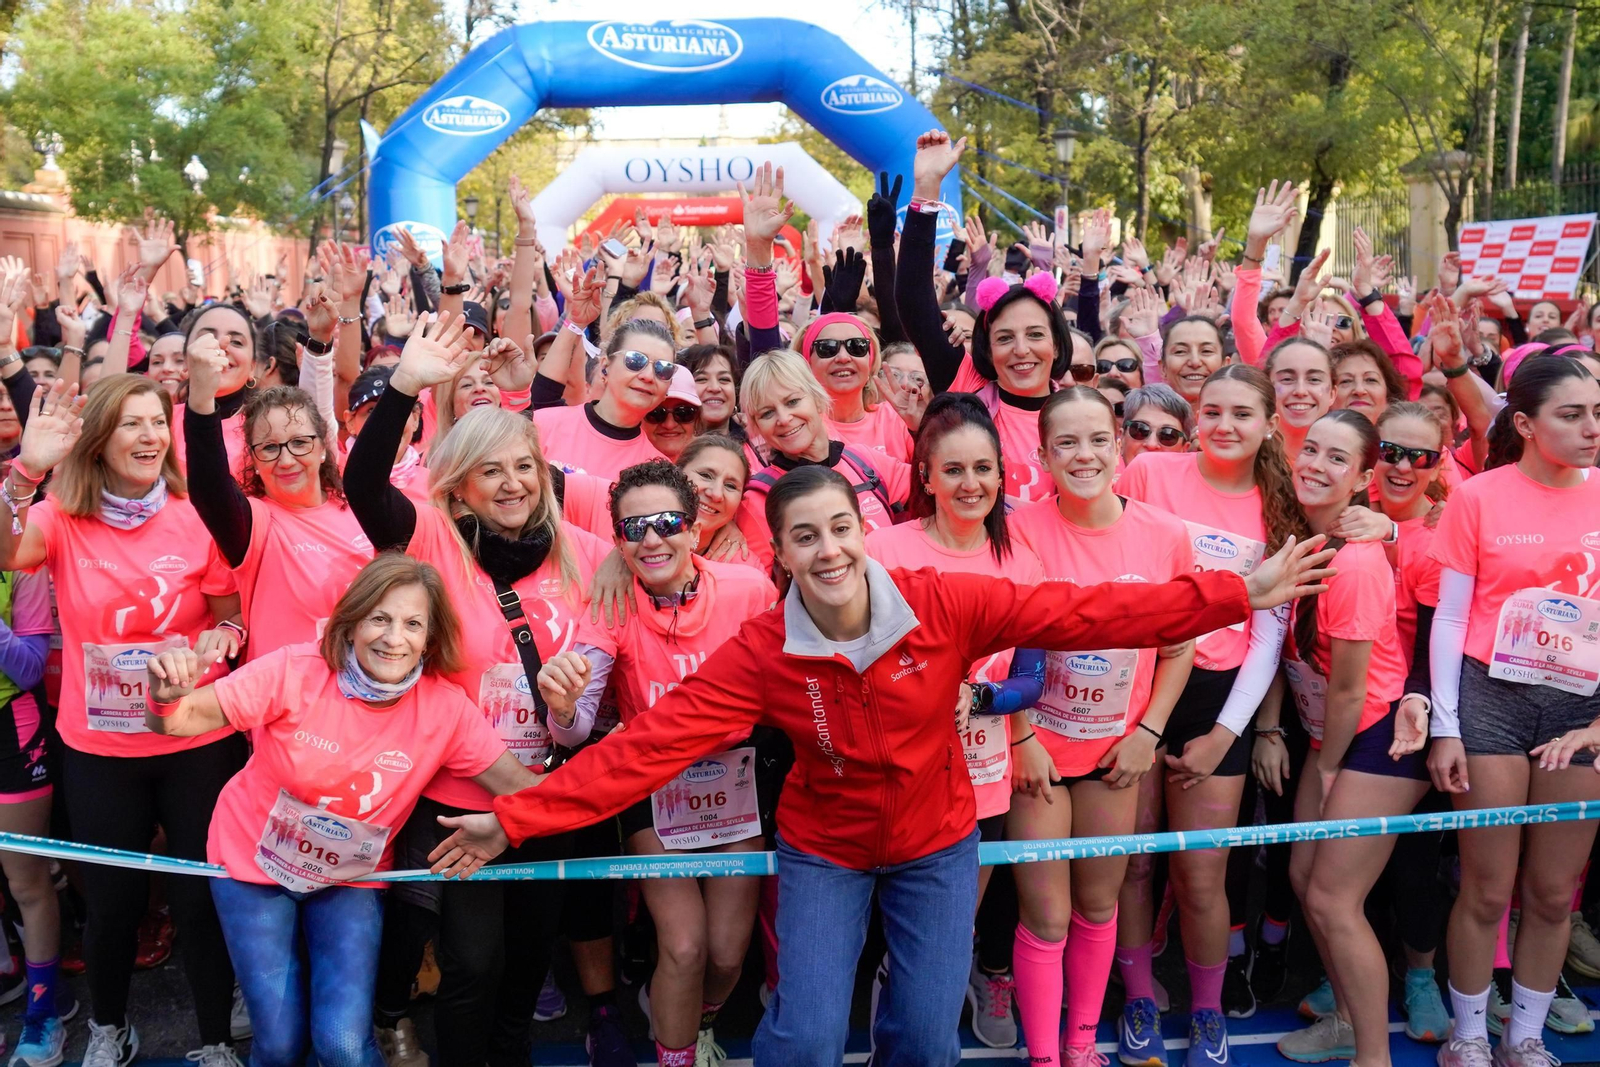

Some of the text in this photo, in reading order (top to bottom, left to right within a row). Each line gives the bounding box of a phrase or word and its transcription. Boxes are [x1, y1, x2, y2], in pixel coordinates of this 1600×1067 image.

[622, 26, 726, 36] CENTRAL LECHERA
[600, 26, 732, 56] ASTURIANA
[828, 90, 898, 106] ASTURIANA
[428, 108, 504, 126] ASTURIANA
[625, 156, 754, 183] OYSHO
[684, 205, 728, 215] Santander
[1496, 534, 1544, 546] OYSHO
[292, 542, 327, 555] YSO
[1197, 539, 1235, 556] ASTURIANA
[78, 558, 118, 570] OYSHO
[152, 562, 186, 570] ASTURIANA
[1512, 601, 1534, 610] SUMA
[1541, 604, 1578, 619] ASTURIANA
[1536, 631, 1573, 651] 016
[115, 658, 148, 666] ASTURIA
[1509, 657, 1532, 666] CARRERA
[1546, 654, 1556, 662] 62
[891, 660, 928, 682] Santander
[1068, 659, 1108, 672] ASTURIANA
[120, 682, 143, 696] 01
[490, 681, 512, 689] SUMA
[1552, 676, 1584, 689] Santander
[1065, 684, 1105, 703] 016
[516, 708, 538, 724] 01
[1042, 705, 1061, 717] CARRERA
[1072, 706, 1091, 714] 4607
[98, 720, 130, 728] OYSHO
[806, 676, 846, 777] #SrtSantander
[1036, 713, 1067, 730] OYSHO
[294, 730, 340, 753] OYSHO
[962, 729, 986, 746] 16
[378, 756, 409, 768] ASTURIANA
[685, 768, 725, 779] ASTURIANA
[689, 792, 727, 810] 016
[1429, 808, 1559, 830] SPORTLIFE
[306, 818, 348, 838] ASTURIANA
[670, 826, 691, 834] CARRERA
[670, 828, 749, 845] OYSHO Santander
[1063, 837, 1114, 846] COMUNICACIÓN
[1117, 834, 1154, 842] MOVILIDAD,
[298, 840, 340, 866] 016
[270, 854, 292, 872] CARRERA
[291, 866, 299, 875] DE
[302, 862, 323, 874] 2026
[610, 864, 642, 872] EVENTOS
[650, 861, 702, 870] COMUNICACIÓN
[264, 862, 295, 884] OYSHO
[662, 1051, 688, 1060] KEEP
